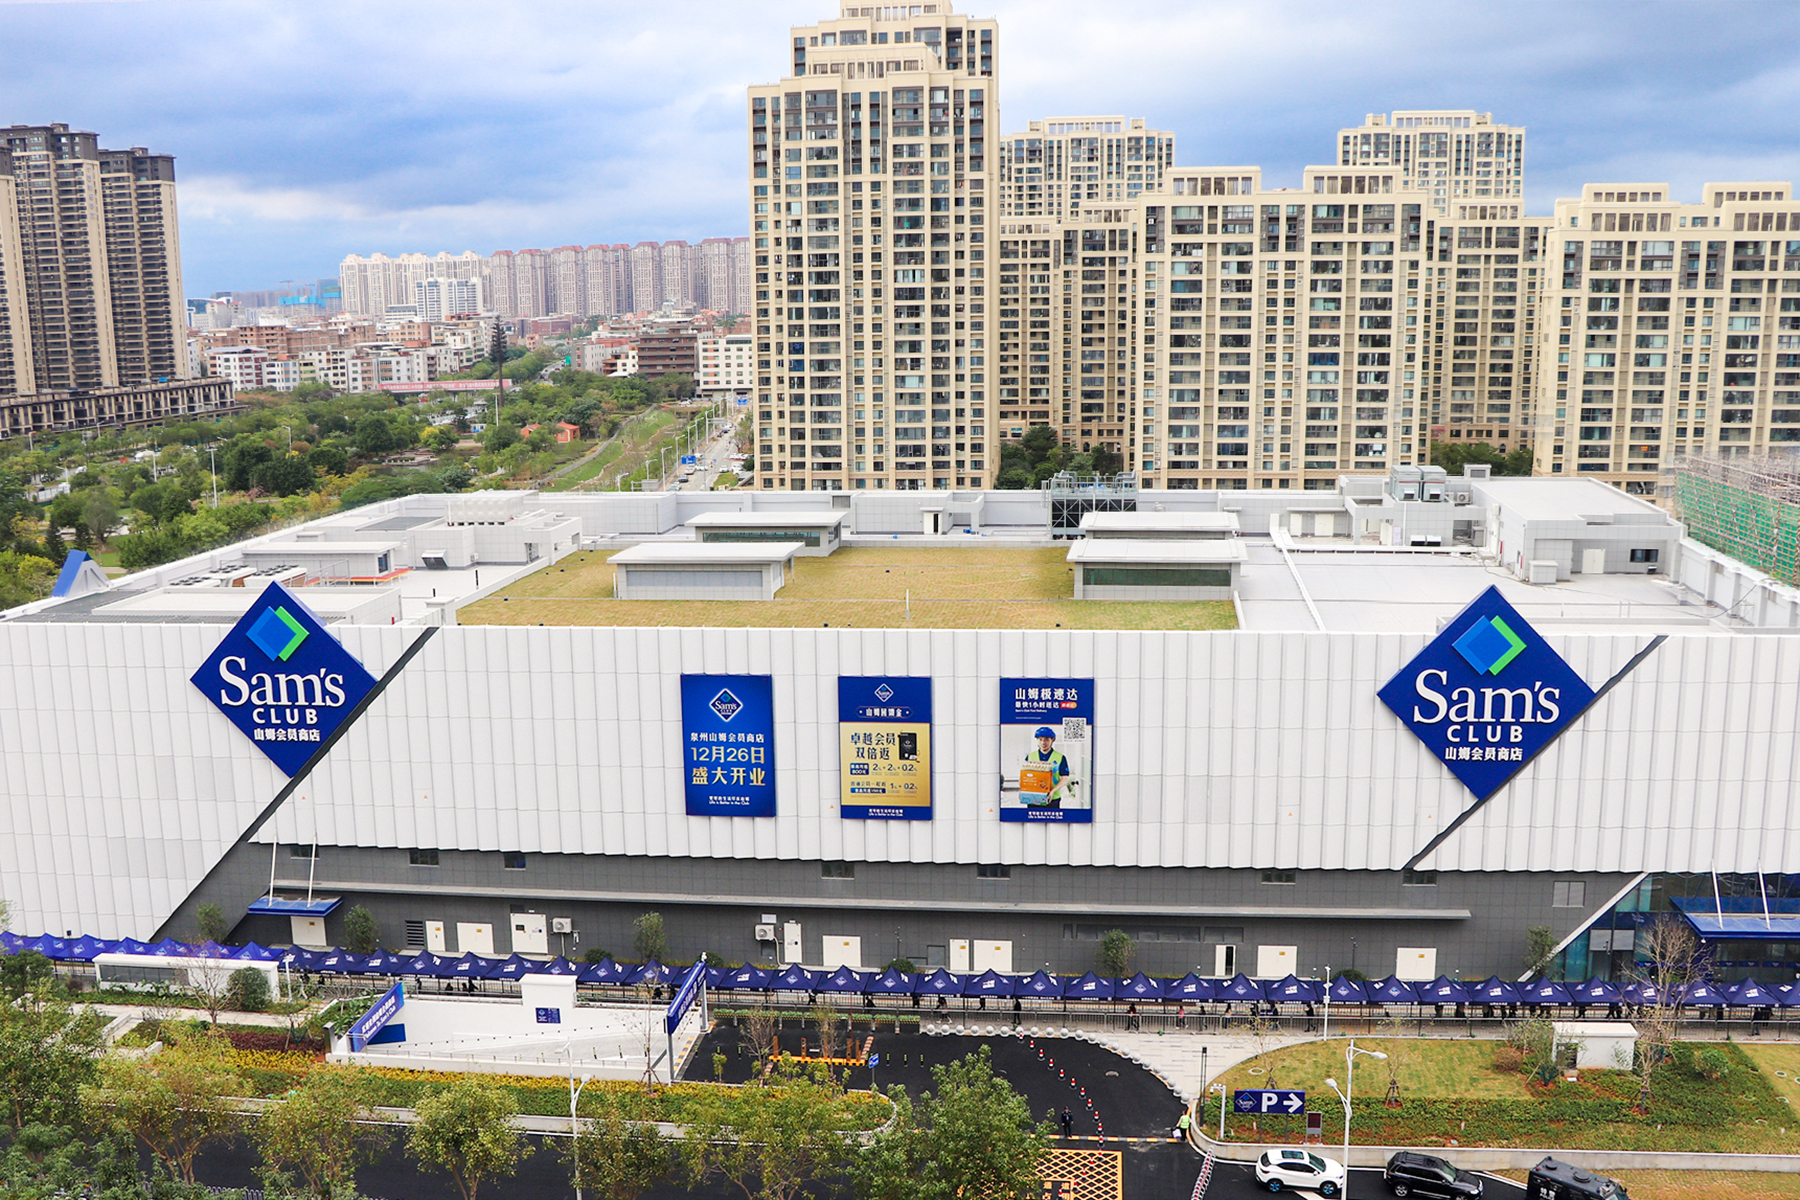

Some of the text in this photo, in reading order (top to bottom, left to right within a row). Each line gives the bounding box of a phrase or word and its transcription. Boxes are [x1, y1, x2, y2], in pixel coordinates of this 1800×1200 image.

[219, 656, 346, 707] Sam's
[1015, 687, 1078, 701] 山姆极速达
[1413, 669, 1560, 724] Sam's
[715, 701, 737, 710] Sam's
[252, 708, 318, 724] CLUB
[254, 728, 320, 742] 山姆会员商店
[690, 732, 764, 743] 泉州山姆会员商店
[850, 732, 896, 746] 卓越会员
[1446, 725, 1523, 742] CLUB
[691, 746, 764, 764] 12月26日
[855, 747, 890, 760] 双倍返
[1445, 747, 1523, 761] 山姆会员商店
[692, 766, 766, 786] 盛大开业
[1261, 1092, 1278, 1112] P
